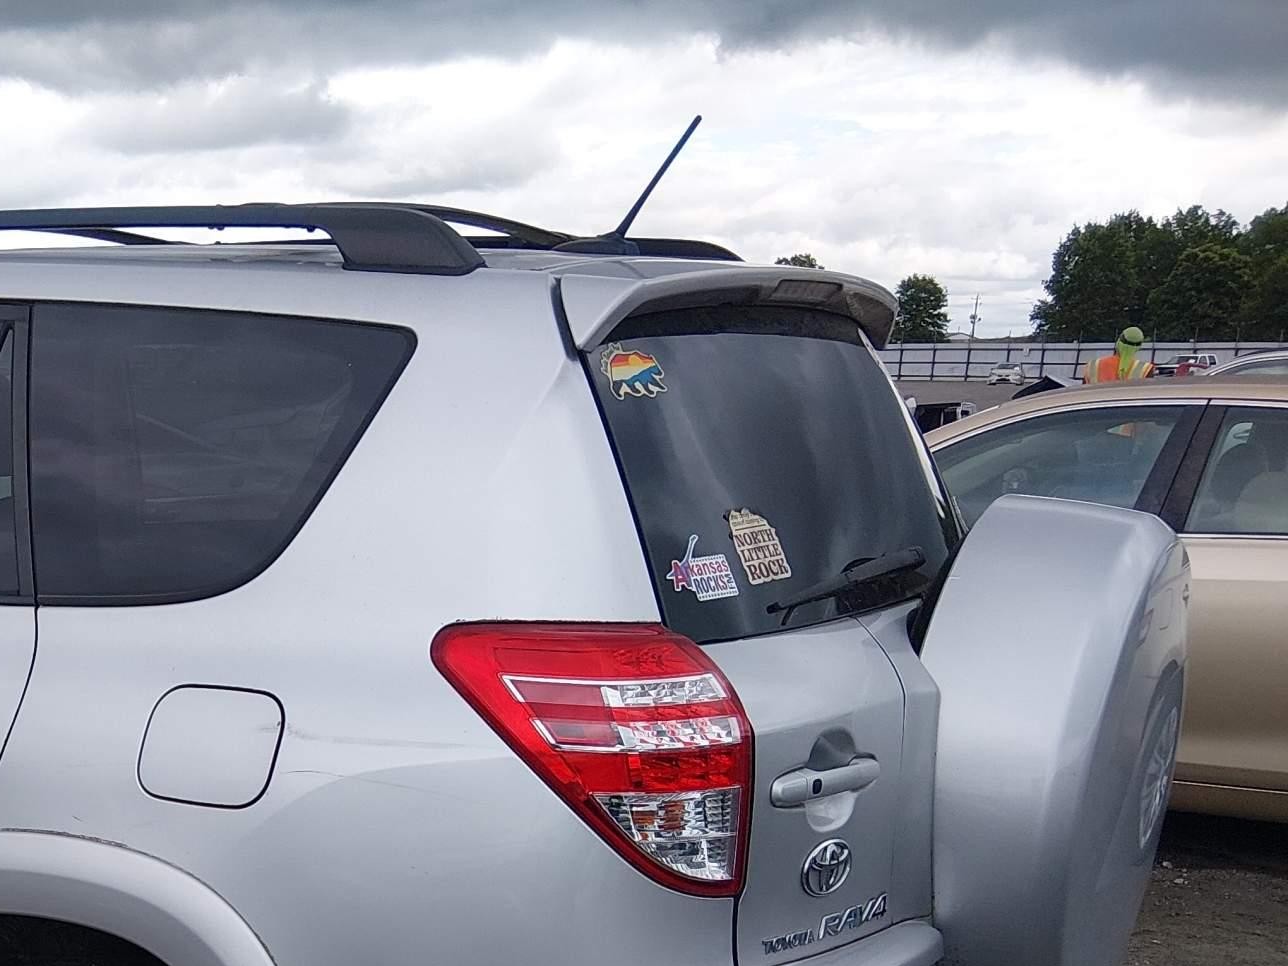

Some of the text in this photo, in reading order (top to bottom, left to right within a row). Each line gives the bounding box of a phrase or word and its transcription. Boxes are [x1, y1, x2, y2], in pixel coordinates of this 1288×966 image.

[734, 528, 775, 548] NORTH
[740, 543, 782, 563] LITTLE
[746, 558, 789, 581] ROCK
[693, 575, 728, 595] ROCKS
[724, 573, 736, 590] FM
[761, 891, 888, 955] TOYOTA RAV4
